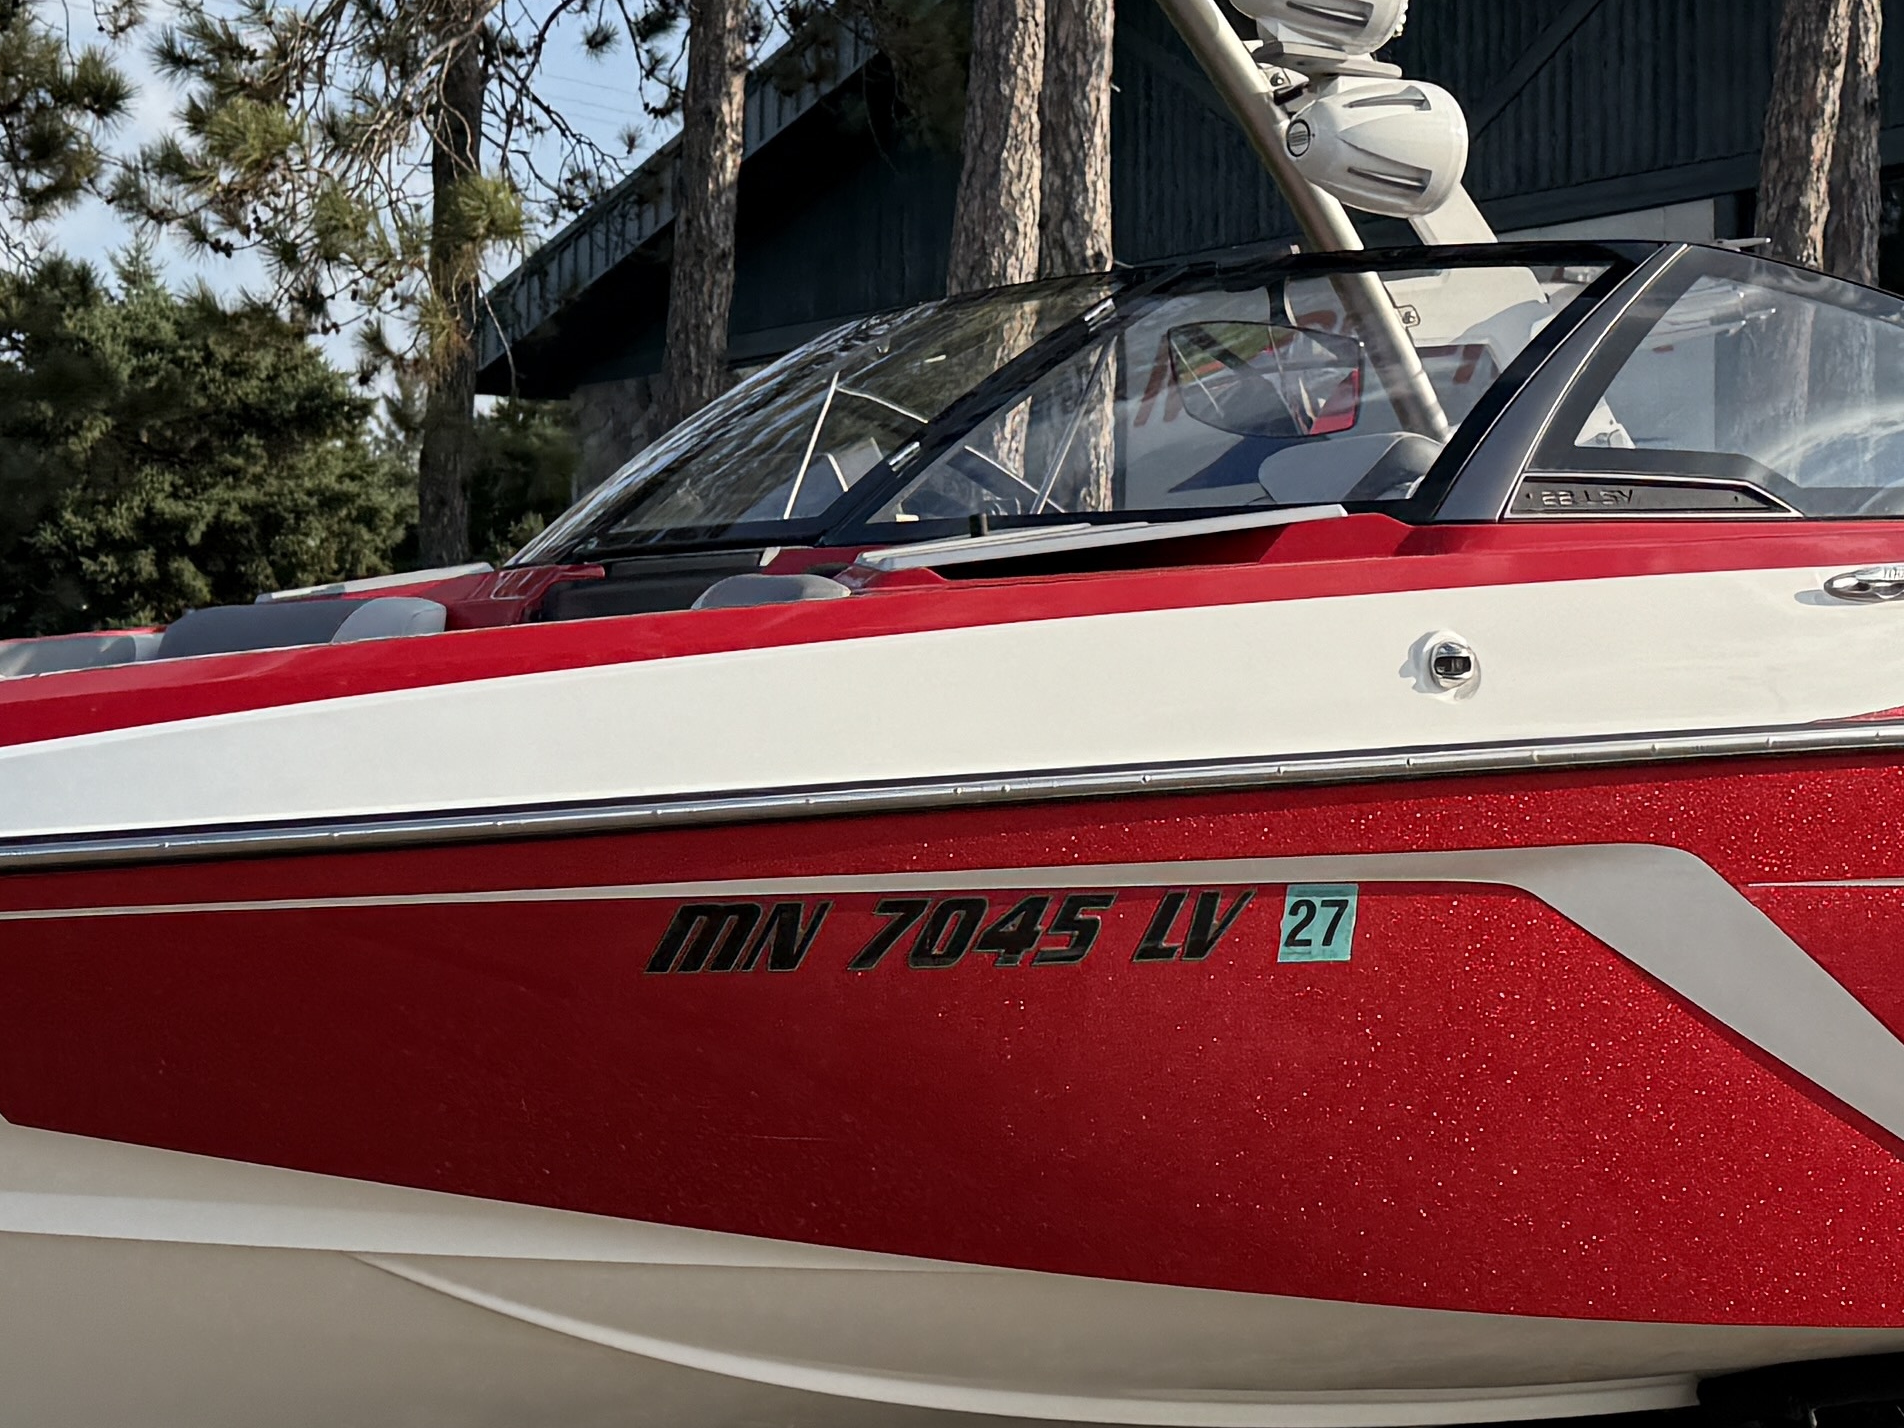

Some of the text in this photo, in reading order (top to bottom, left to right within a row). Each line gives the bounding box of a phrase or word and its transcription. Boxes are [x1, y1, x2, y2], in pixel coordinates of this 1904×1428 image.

[643, 888, 1257, 974] MN 7045 LV
[1284, 898, 1350, 948] 27
